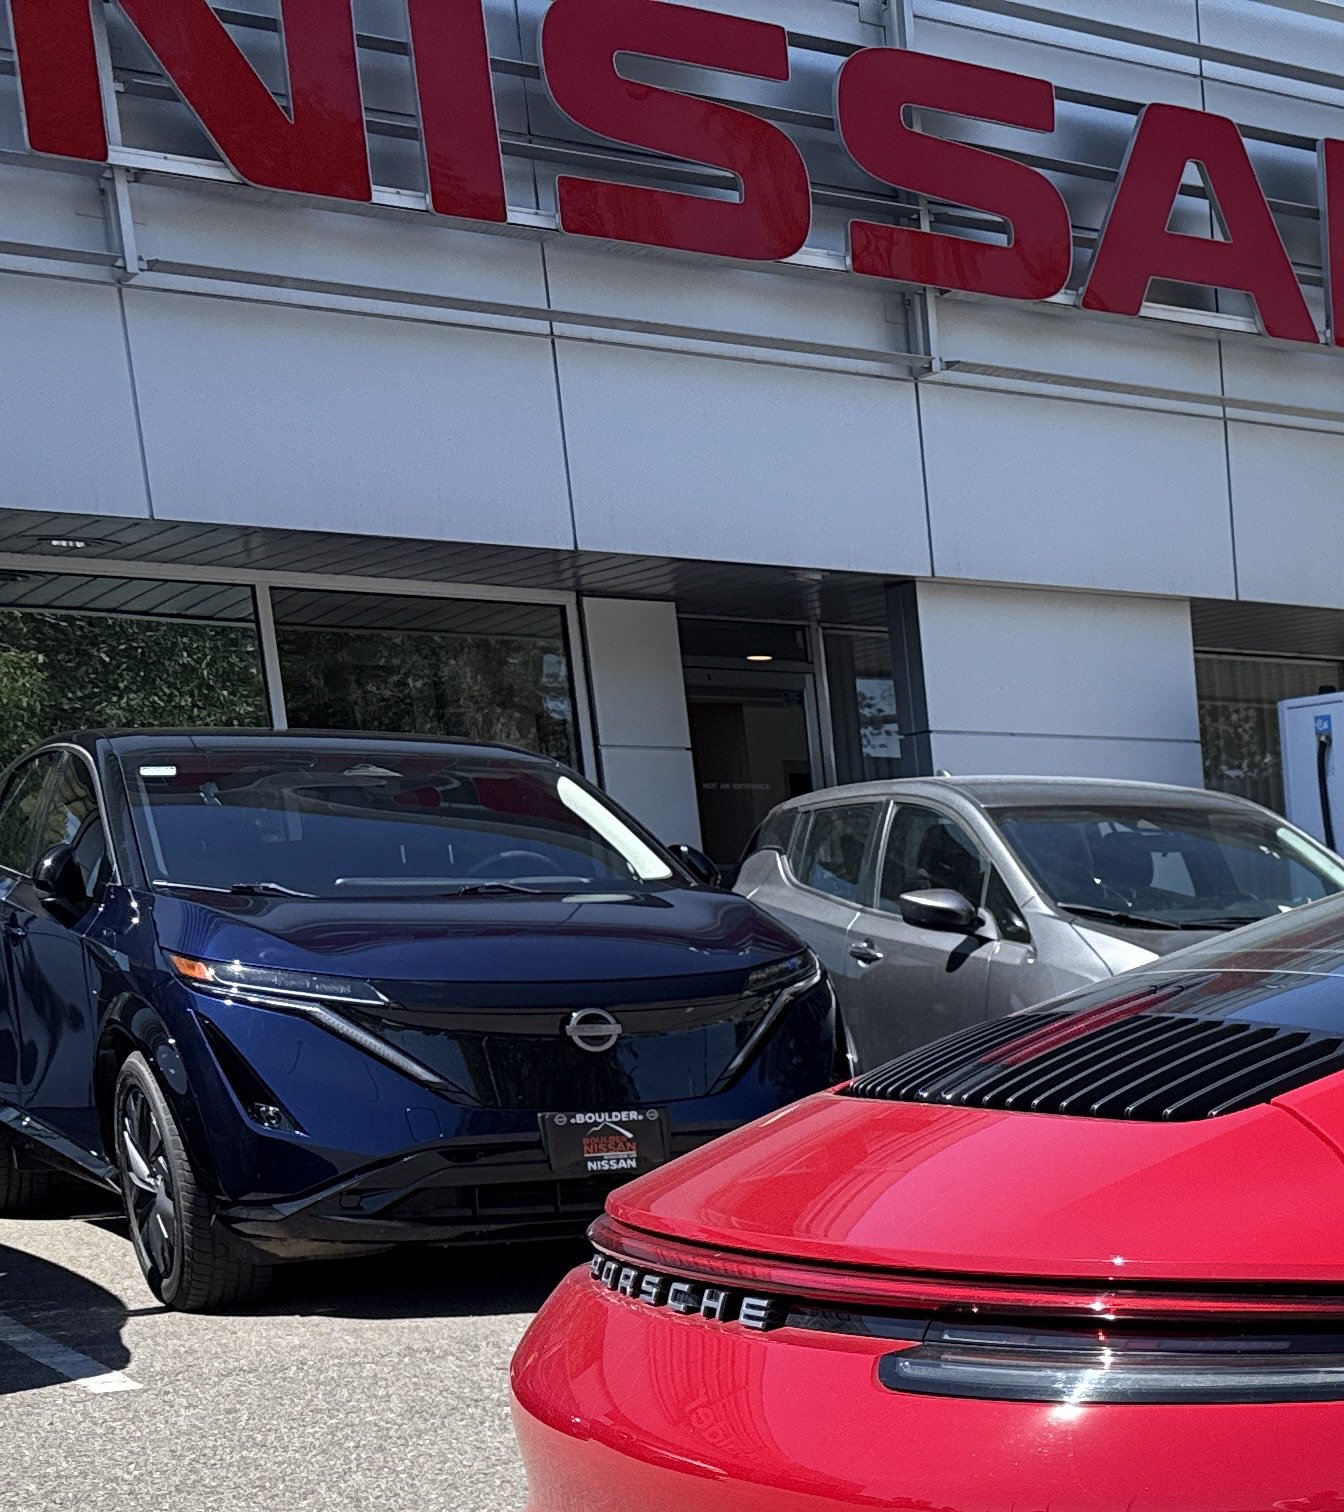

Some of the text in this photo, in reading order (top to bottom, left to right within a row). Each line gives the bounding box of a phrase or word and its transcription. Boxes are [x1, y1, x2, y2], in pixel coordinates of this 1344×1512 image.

[576, 1111, 638, 1124] BOULDER
[587, 1159, 637, 1172] NISSAN
[591, 1254, 771, 1329] PORSCHE
